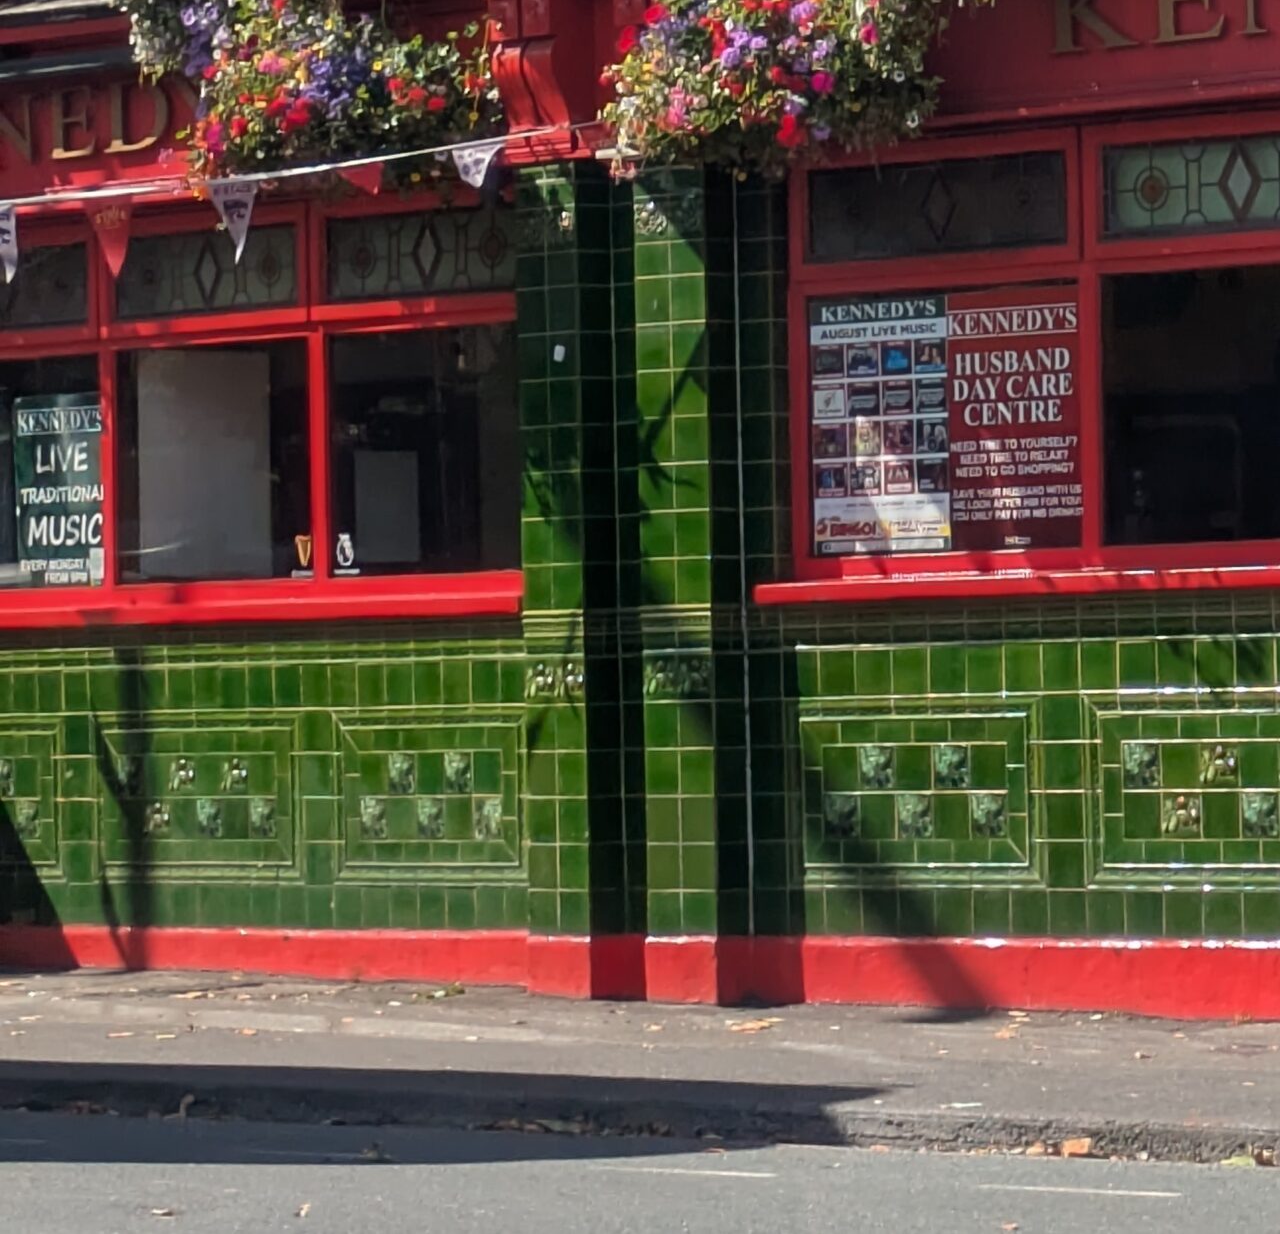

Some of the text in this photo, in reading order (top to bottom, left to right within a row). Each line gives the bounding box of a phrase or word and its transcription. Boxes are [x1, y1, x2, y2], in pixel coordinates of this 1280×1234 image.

[821, 300, 936, 323] KENNEDY'S
[948, 307, 1077, 336] KENNEDY'S
[820, 323, 937, 340] AUGUST LIVE MUSIC
[955, 347, 1070, 376] HUSBAND
[953, 372, 1073, 402] DAY CARE
[964, 399, 1062, 426] CENTRE
[36, 442, 88, 473] LIVE
[21, 484, 104, 504] TRADITIONA
[28, 513, 103, 547] MUSIC
